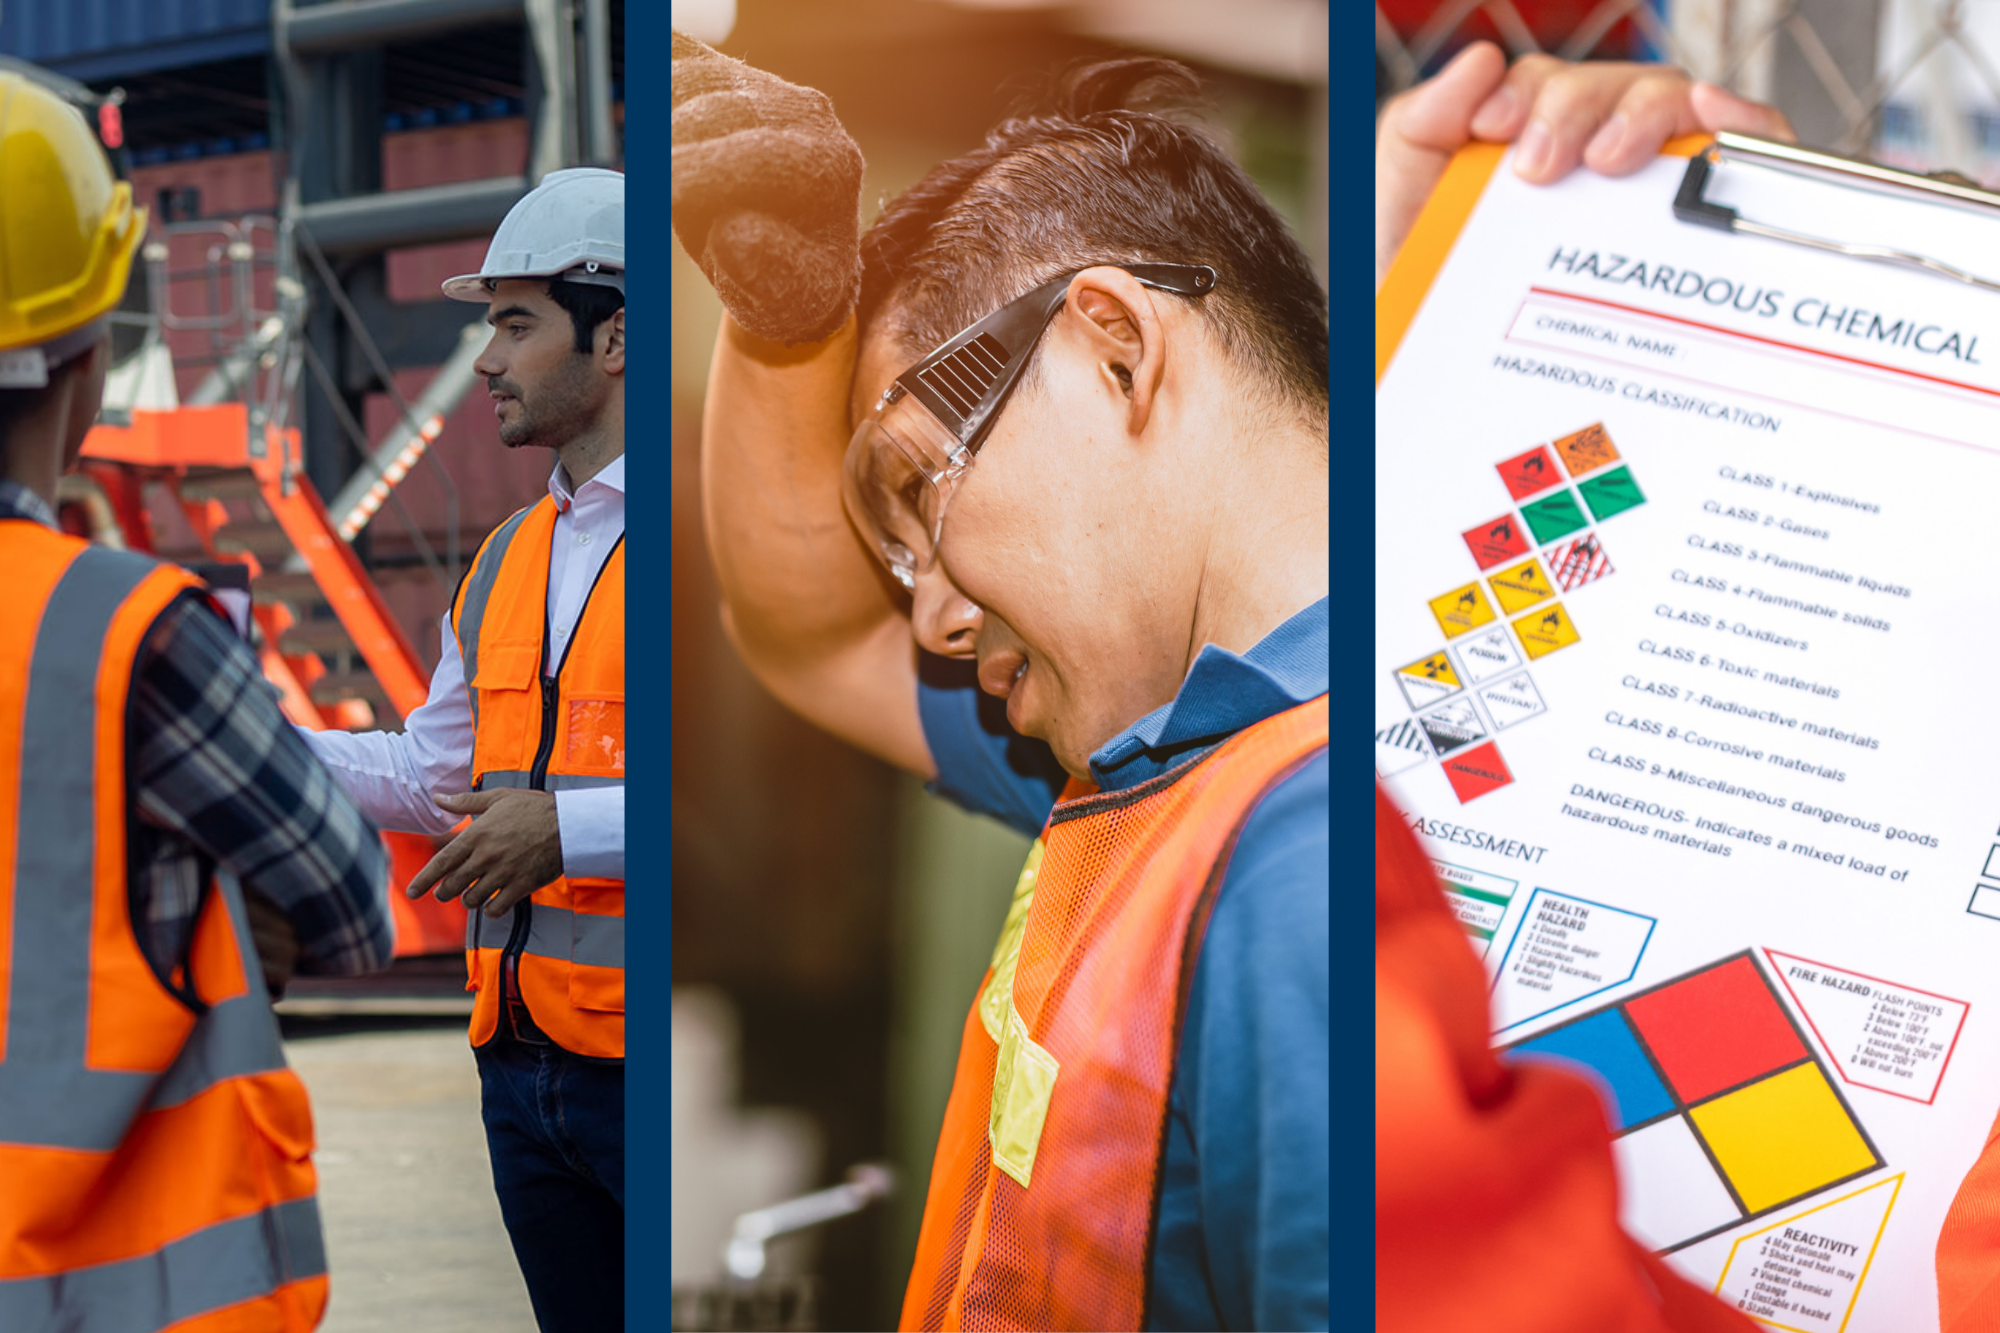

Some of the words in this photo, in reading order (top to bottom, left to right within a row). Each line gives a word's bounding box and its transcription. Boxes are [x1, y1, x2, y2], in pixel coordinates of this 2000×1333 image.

[1548, 245, 1784, 318] HAZARDOUS
[1792, 299, 1982, 365] CHEMICAL
[1536, 315, 1621, 344] CHEMICAL
[1626, 335, 1677, 359] NAME
[1493, 354, 1618, 395] HAZARDOUS
[1621, 382, 1782, 433] CLASSIFICATION
[1719, 465, 1774, 489] CLASS
[1781, 482, 1881, 514] 1-Explosives
[1703, 500, 1758, 523] CLASS
[1763, 514, 1830, 540] 2-Gases
[1687, 534, 1743, 557] CLASS
[1748, 549, 1854, 584] 3-Flammable
[1858, 575, 1912, 598] liquids
[1671, 568, 1727, 592] CLASS
[1733, 584, 1838, 620] 4-Flammable
[1843, 610, 1891, 632] solids
[1655, 603, 1710, 627] CLASS
[1716, 619, 1809, 651] 5-Oxidizers
[1639, 638, 1695, 663] CLASS
[1700, 654, 1759, 680] 6-Toxic
[1763, 667, 1841, 699] materials
[1622, 674, 1679, 698] CLASS
[1684, 689, 1797, 729] 7-Radioactive
[1802, 717, 1880, 750] materials
[1605, 710, 1662, 735] CLASS
[1667, 726, 1763, 761] 8-Corrosive
[1768, 750, 1846, 782] materials
[1588, 746, 1645, 771] CLASS
[1650, 762, 1786, 809] 9-Miscellaneous
[1792, 799, 1881, 834] dangerous
[1885, 825, 1939, 848] goods
[1411, 817, 1549, 864] ASSESSMENT
[1561, 803, 1649, 835] hazardous
[1653, 825, 1732, 858] materials
[1570, 783, 1689, 823] DANGEROUS-
[1695, 816, 1773, 846] Indicates
[1777, 839, 1788, 850] a
[1792, 840, 1844, 867] mixed
[1848, 855, 1886, 877] load
[1890, 867, 1909, 883] of
[1449, 897, 1485, 912] ORPTION
[1460, 911, 1498, 926] CONTACT
[1542, 899, 1590, 919] HEALTH
[1537, 911, 1586, 931] HAZARD
[1540, 924, 1568, 939] Deadly
[1531, 945, 1574, 963] Hazardous
[1535, 934, 1569, 950] Extreme
[1571, 945, 1601, 959] danger
[1517, 977, 1553, 992] material
[1559, 964, 1602, 982] hazardous
[1789, 966, 1818, 983] FIRE
[1821, 975, 1871, 996] HAZARD
[1872, 990, 1904, 1007] FLASH
[1906, 999, 1943, 1017] POINTS
[1872, 1002, 1878, 1011] 4
[1880, 1004, 1906, 1019] Below
[1876, 1014, 1902, 1029] Below
[1863, 1023, 1870, 1032] 2
[1871, 1025, 1898, 1040] Above
[1867, 1037, 1910, 1056] exceeding
[1863, 1046, 1889, 1061] Above
[1878, 1062, 1893, 1073] not
[1894, 1065, 1914, 1079] burn
[1765, 1236, 1772, 1245] 4
[1772, 1237, 1792, 1251] May
[1793, 1245, 1831, 1262] detonate
[1783, 1227, 1859, 1257] REACTIVITY
[1760, 1246, 1767, 1256] 3
[1768, 1247, 1795, 1263] Shock
[1797, 1257, 1814, 1269] and
[1815, 1261, 1835, 1275] heat
[1837, 1269, 1856, 1282] may
[1764, 1260, 1802, 1278] detonate
[1751, 1267, 1758, 1277] 2
[1760, 1269, 1791, 1286] Violent
[1792, 1279, 1833, 1298] chemical
[1755, 1281, 1787, 1297] change
[1738, 1300, 1745, 1309] 0
[1746, 1302, 1775, 1318] Stable
[1743, 1289, 1749, 1298] 1
[1751, 1291, 1789, 1310] Unstable
[1791, 1302, 1799, 1312] if
[1799, 1304, 1831, 1321] heated
